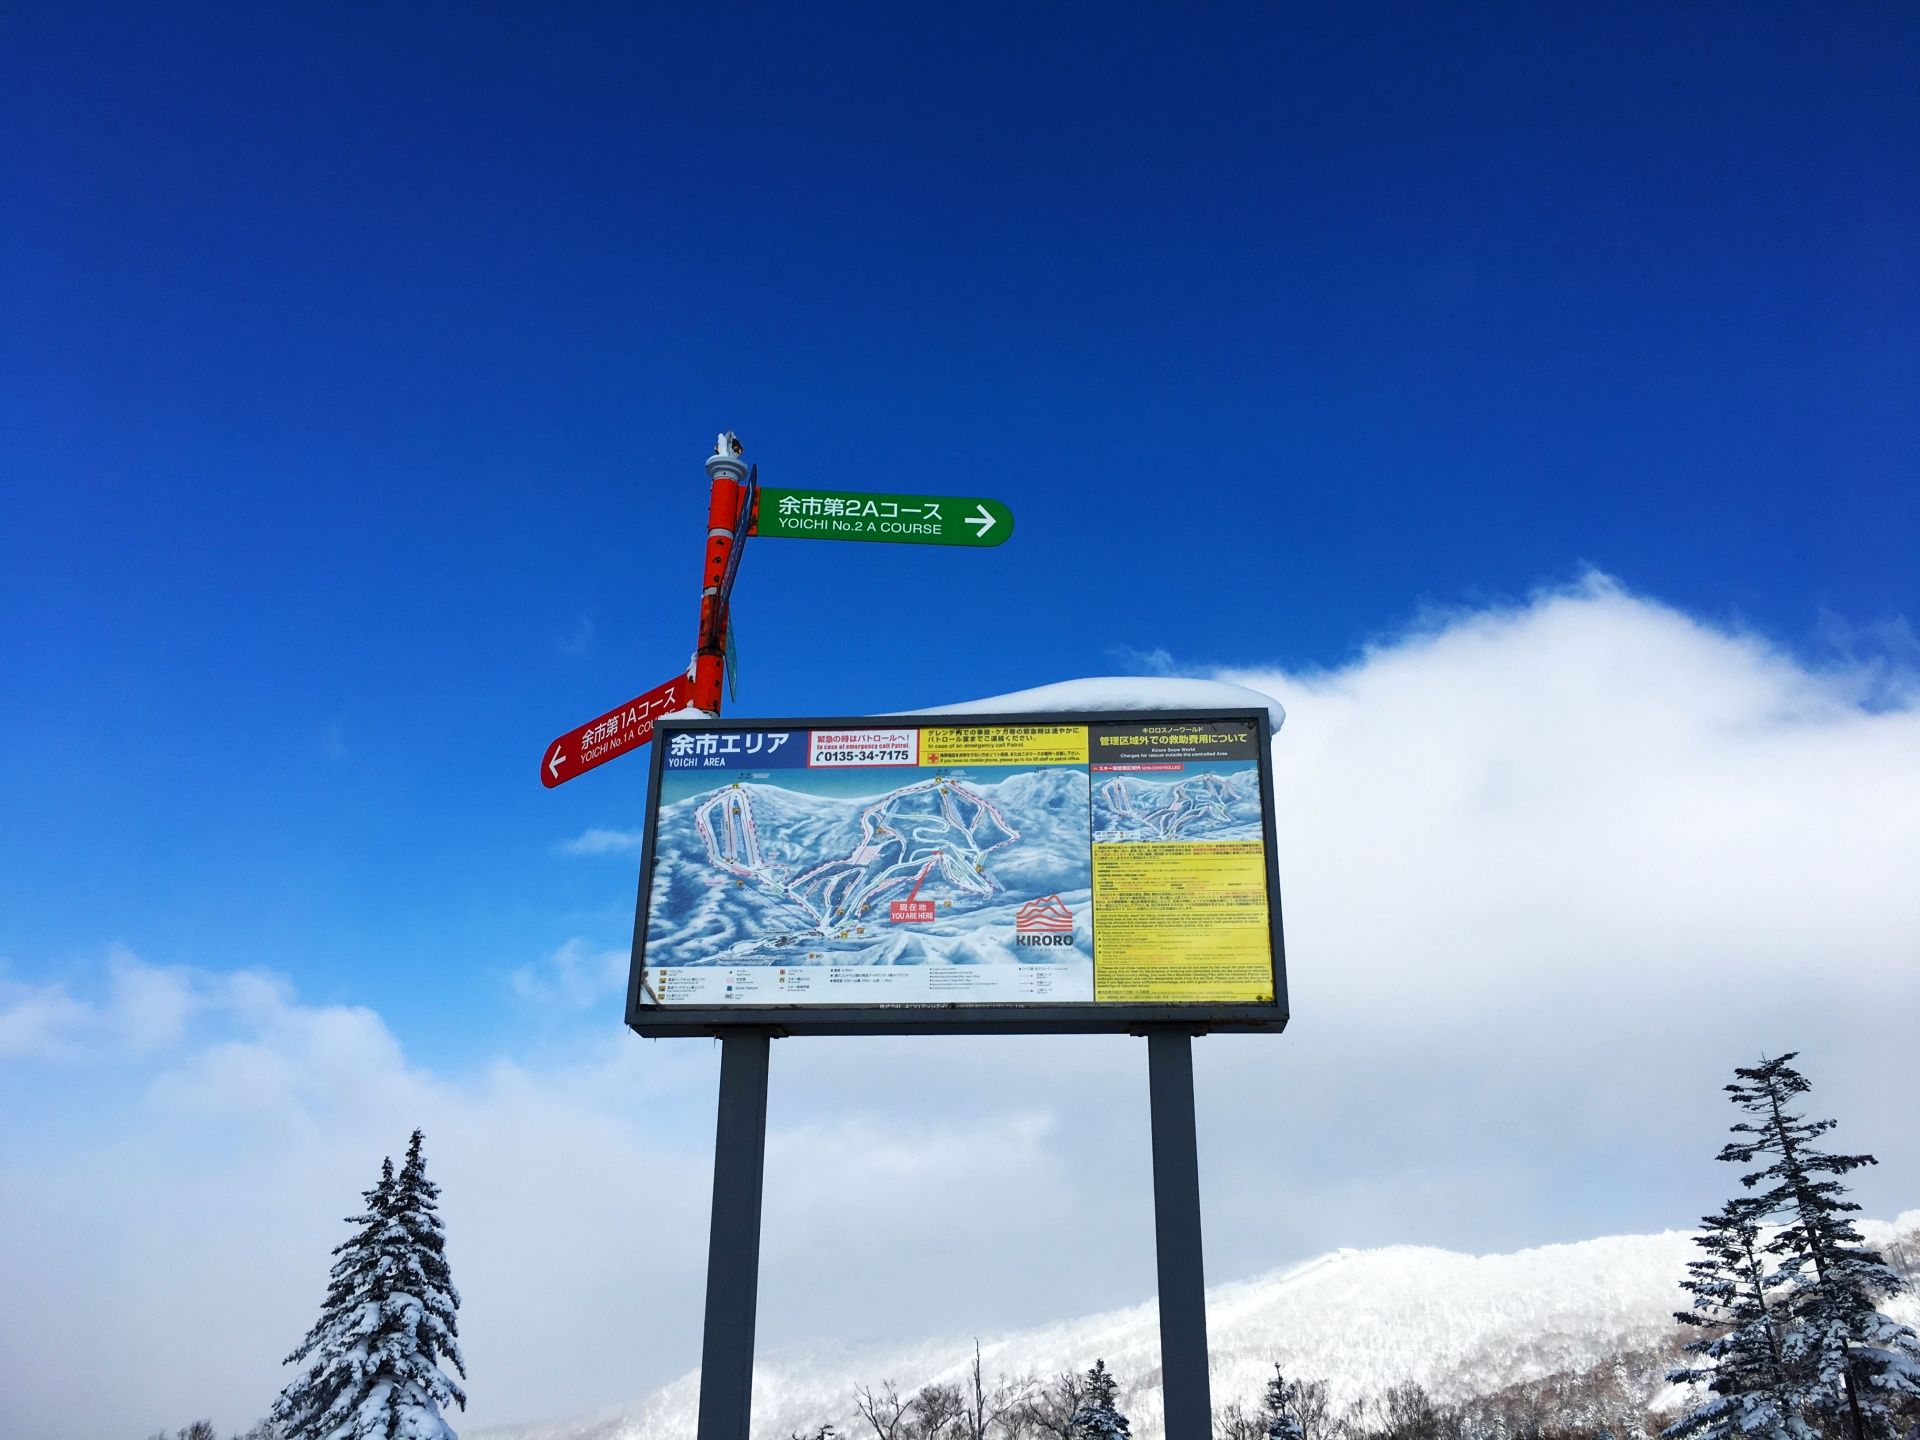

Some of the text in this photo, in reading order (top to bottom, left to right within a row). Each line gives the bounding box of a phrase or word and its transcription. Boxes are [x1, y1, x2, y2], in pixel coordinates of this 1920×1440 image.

[779, 496, 943, 520] 余市第2Aコース
[779, 518, 942, 535] YOICHI No.2 A COURSE
[581, 686, 676, 750] 余市第1Aコース
[671, 733, 790, 756] 余市エリア
[846, 743, 878, 751] emergency
[580, 742, 609, 764] YOICHI
[824, 750, 909, 762] 0135-34-7175
[668, 757, 726, 767] YOICHI AREA
[891, 911, 934, 920] YOU ARE HERE
[1016, 935, 1074, 946] KIRORO
